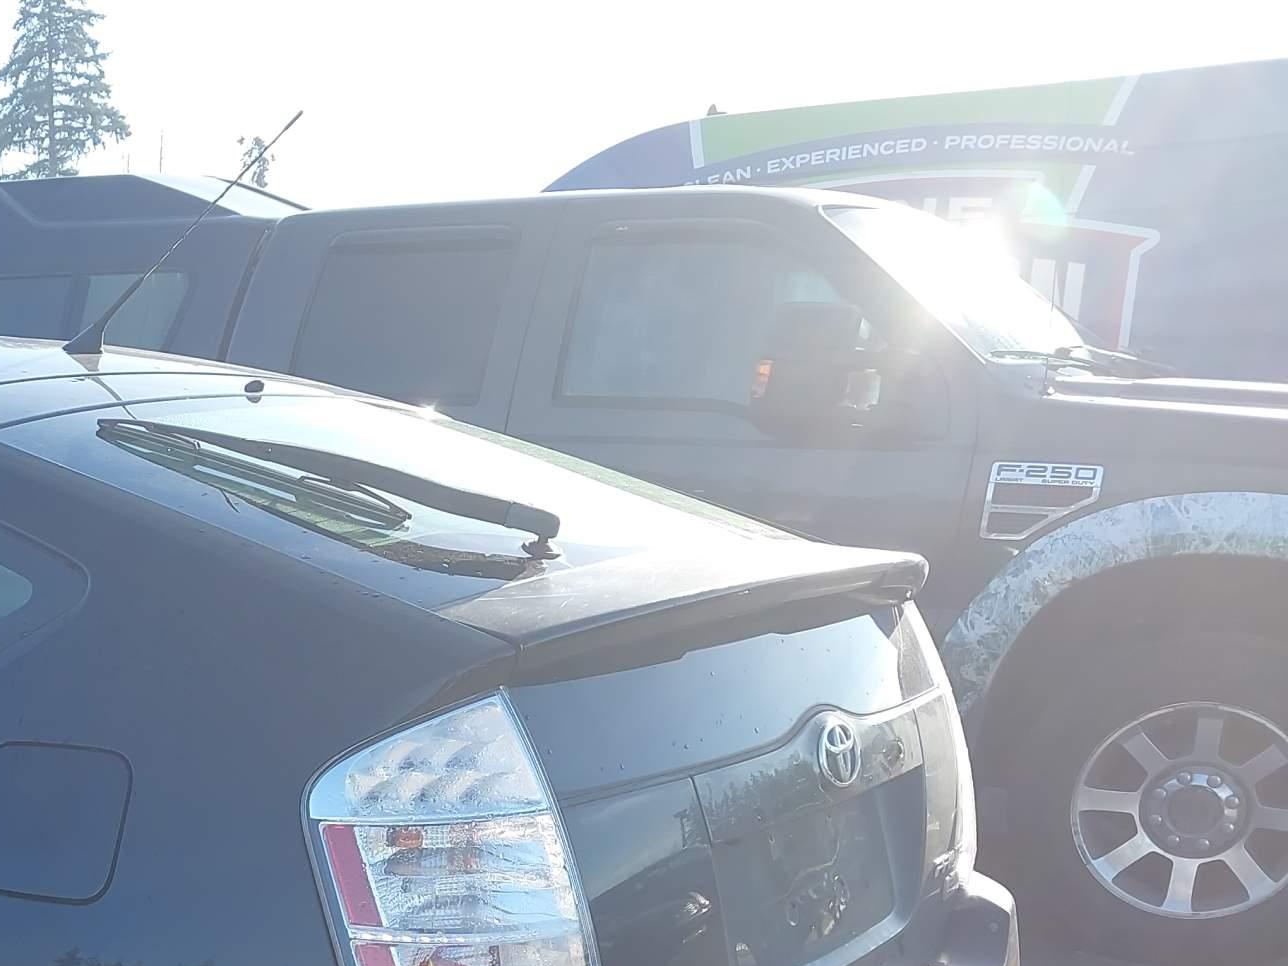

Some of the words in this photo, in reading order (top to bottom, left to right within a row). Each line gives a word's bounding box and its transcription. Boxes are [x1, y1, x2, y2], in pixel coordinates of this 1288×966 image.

[684, 166, 751, 186] EAN
[767, 138, 927, 174] EXPERIENCED
[944, 134, 1136, 156] PROFESSIONAL
[996, 464, 1098, 481] F-250
